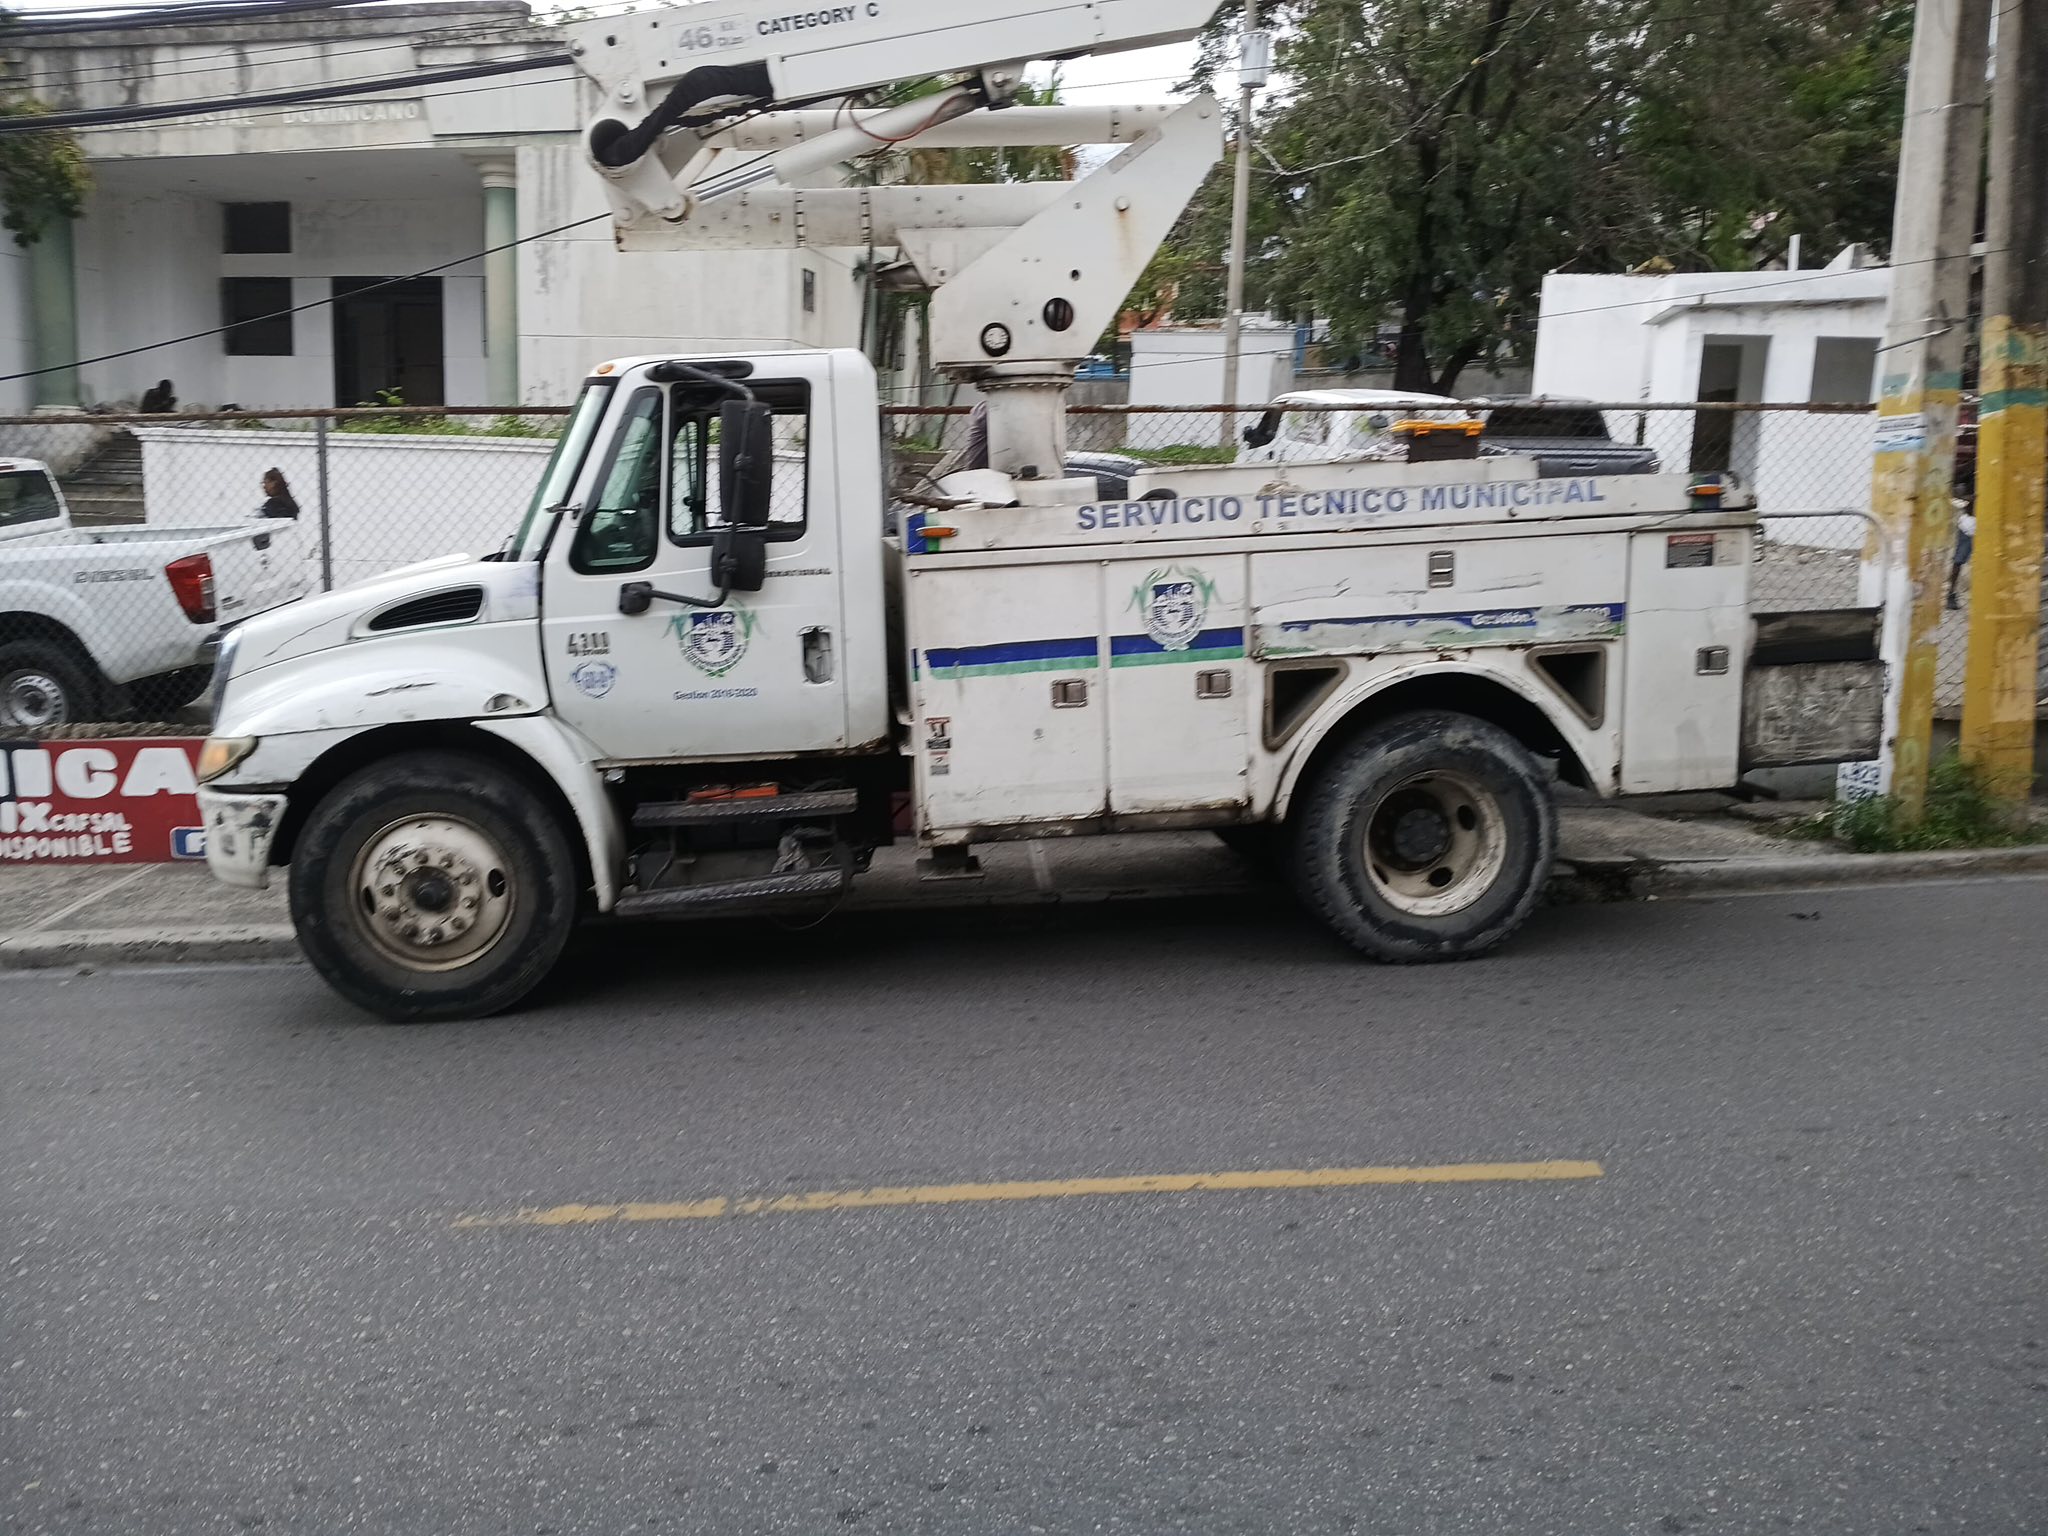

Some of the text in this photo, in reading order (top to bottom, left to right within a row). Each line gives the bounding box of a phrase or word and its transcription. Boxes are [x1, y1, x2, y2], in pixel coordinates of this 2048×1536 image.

[679, 26, 713, 50] 46
[756, 5, 857, 36] CATEGORY
[865, 2, 880, 17] C
[282, 103, 419, 125] DOMINICANO
[1077, 479, 1606, 531] SERVICIO TECNICO MUNICIPAL
[0, 747, 198, 798] ICA
